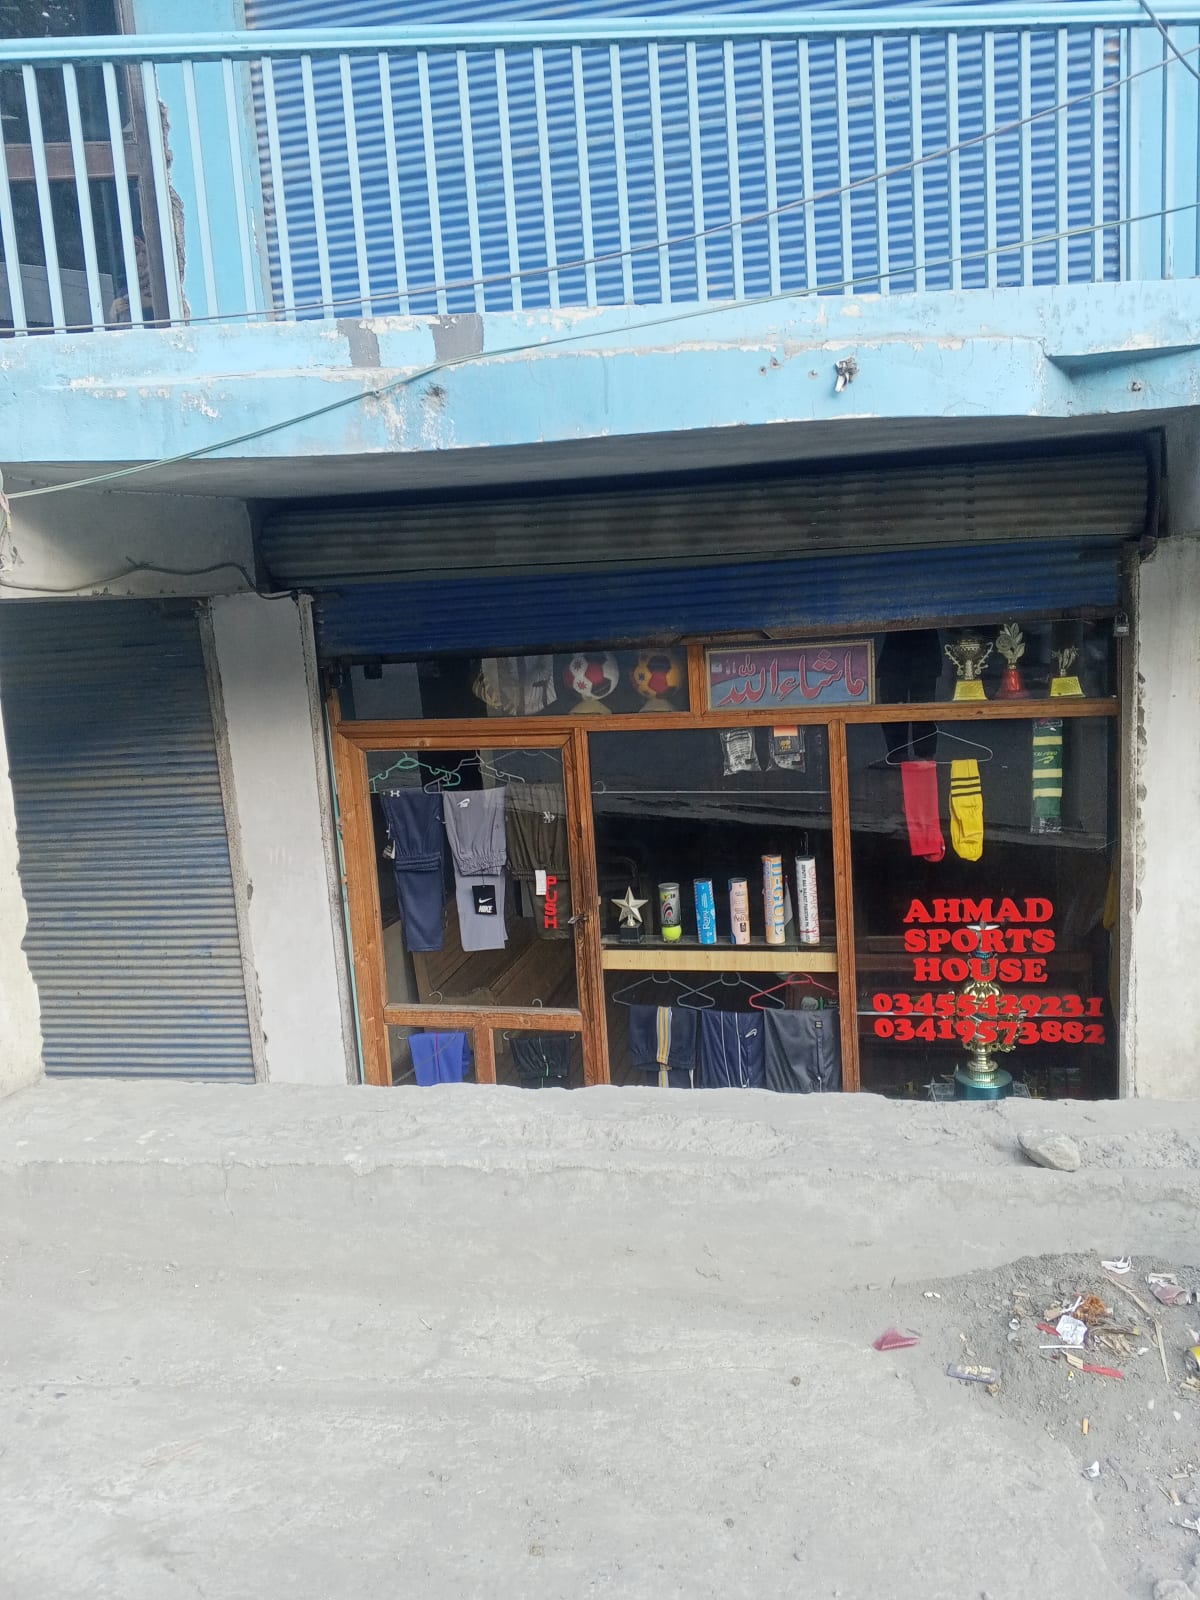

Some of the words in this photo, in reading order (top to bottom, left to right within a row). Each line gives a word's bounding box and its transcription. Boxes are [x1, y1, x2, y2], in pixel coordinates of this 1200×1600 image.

[544, 875, 559, 929] PUSH
[903, 897, 1054, 923] AHMAD
[904, 929, 1056, 953] SPORTS
[913, 957, 1048, 982] HOUSE
[872, 993, 1104, 1017] 03455429231
[873, 1018, 1105, 1045] 03419573882
